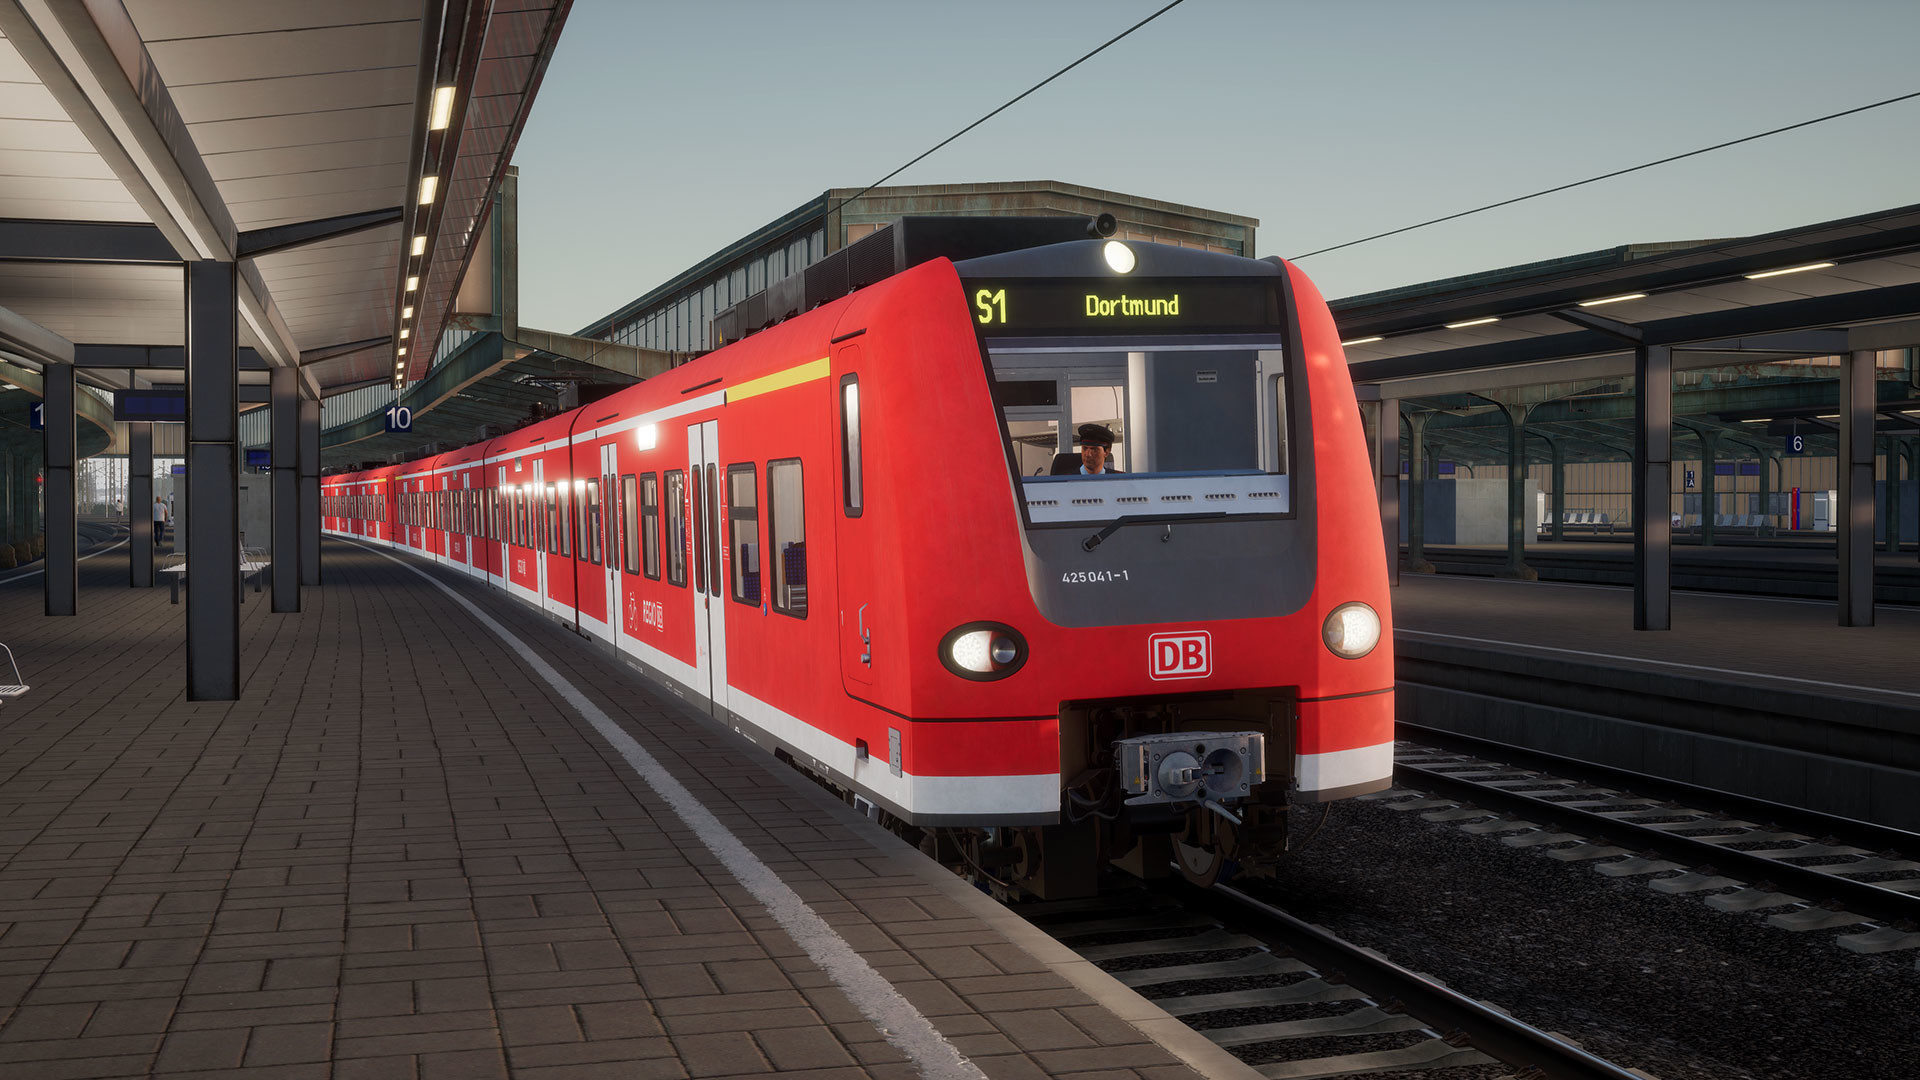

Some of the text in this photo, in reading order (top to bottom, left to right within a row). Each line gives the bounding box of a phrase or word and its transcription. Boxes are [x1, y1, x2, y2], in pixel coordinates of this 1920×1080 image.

[976, 289, 1179, 324] S1 Dortmund
[386, 407, 411, 429] 10
[1793, 435, 1803, 452] 6
[1062, 570, 1129, 583] 425041-1
[643, 600, 657, 627] REGIO
[1156, 638, 1206, 673] DB
